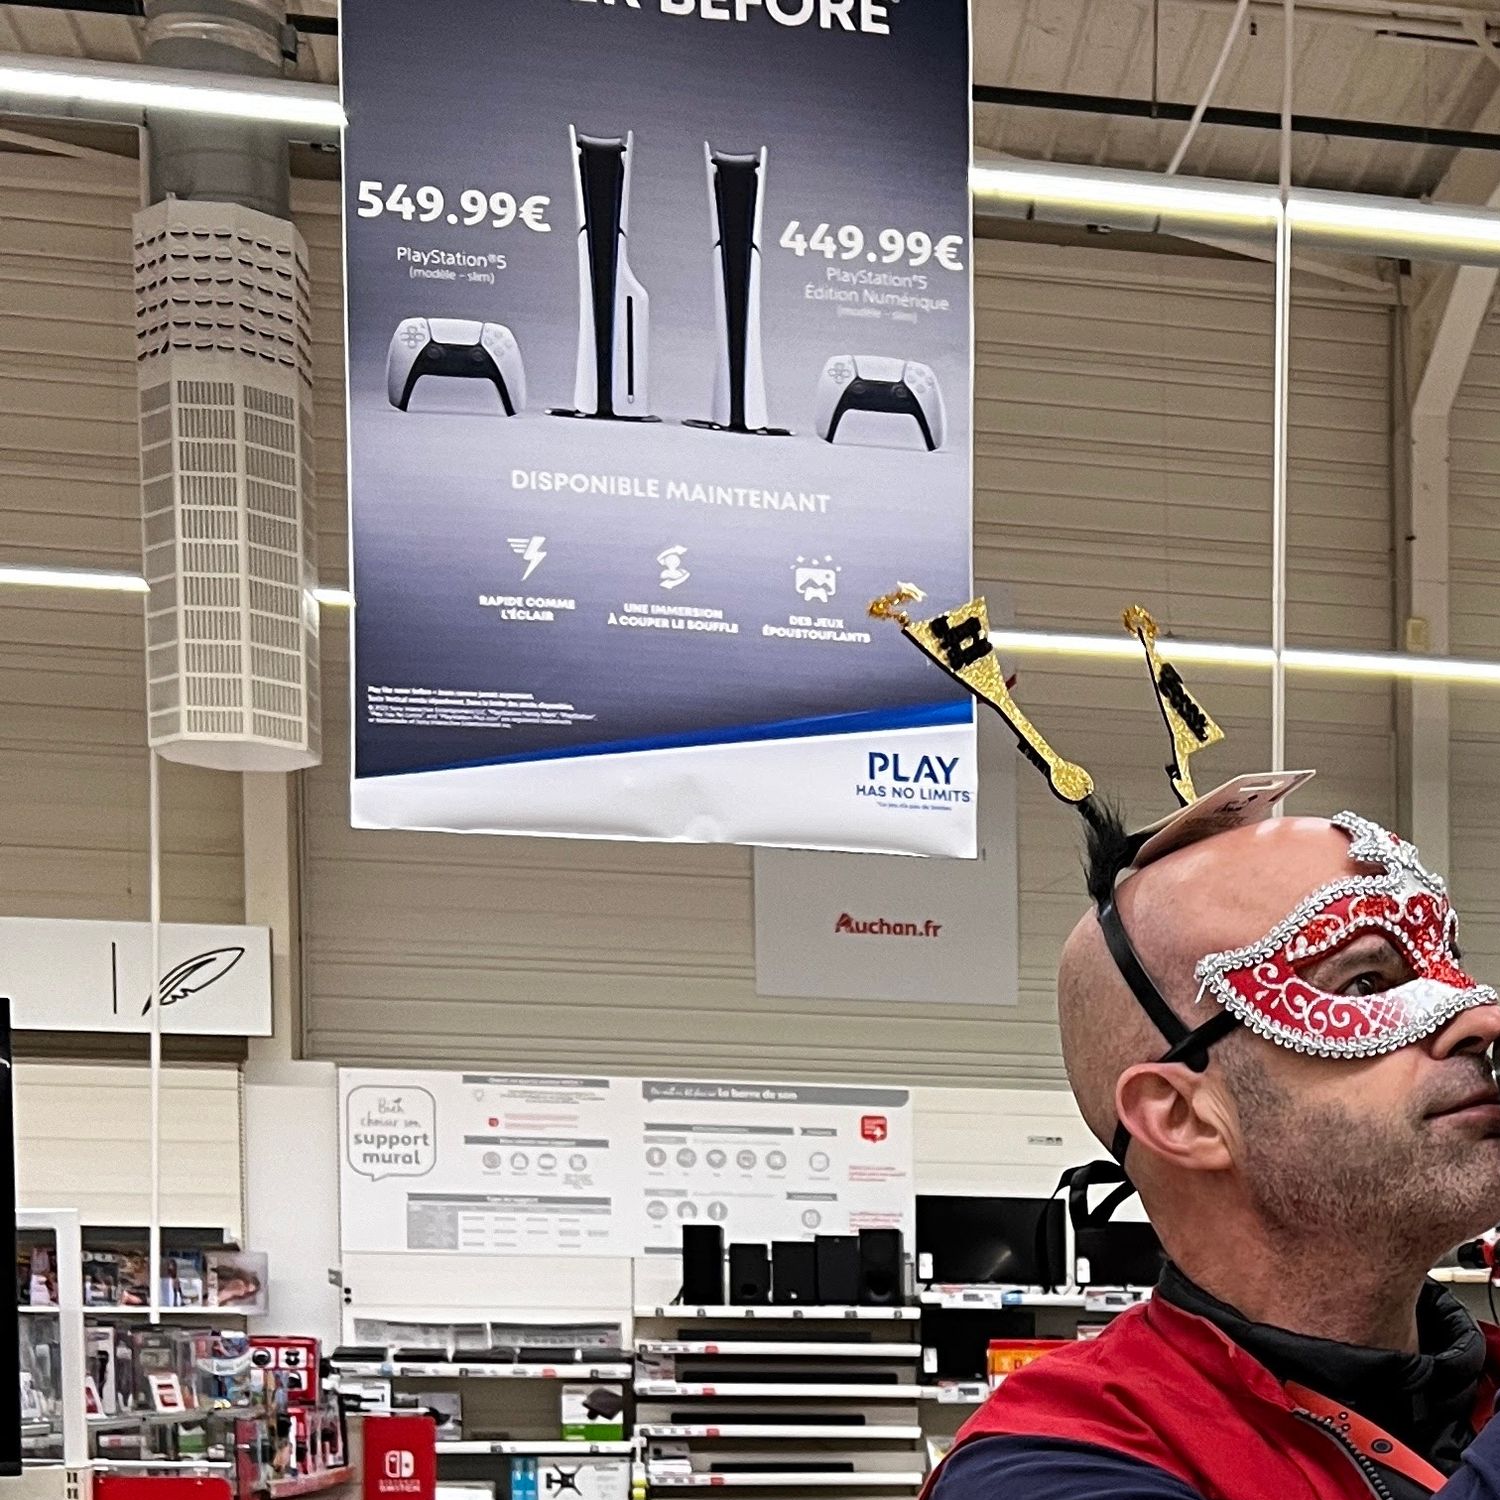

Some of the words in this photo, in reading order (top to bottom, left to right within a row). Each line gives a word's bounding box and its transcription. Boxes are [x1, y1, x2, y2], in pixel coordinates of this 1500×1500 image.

[358, 180, 551, 232] 549.99€
[779, 220, 964, 271] 449.99€
[511, 469, 660, 498] DISPONIBLE
[666, 481, 831, 513] MAINTENANT
[479, 595, 522, 609] RAPIDE
[525, 597, 576, 610] COMME
[619, 614, 669, 628] COUPER
[687, 618, 739, 634] SOUFFLE
[816, 617, 844, 629] JEUX
[868, 751, 960, 785] PLAY
[856, 785, 887, 797] HAS
[892, 786, 915, 799] NO
[920, 788, 971, 803] LIMITS
[834, 912, 942, 937] Auchan.fr
[353, 1132, 430, 1149] support
[362, 1149, 421, 1165] mural
